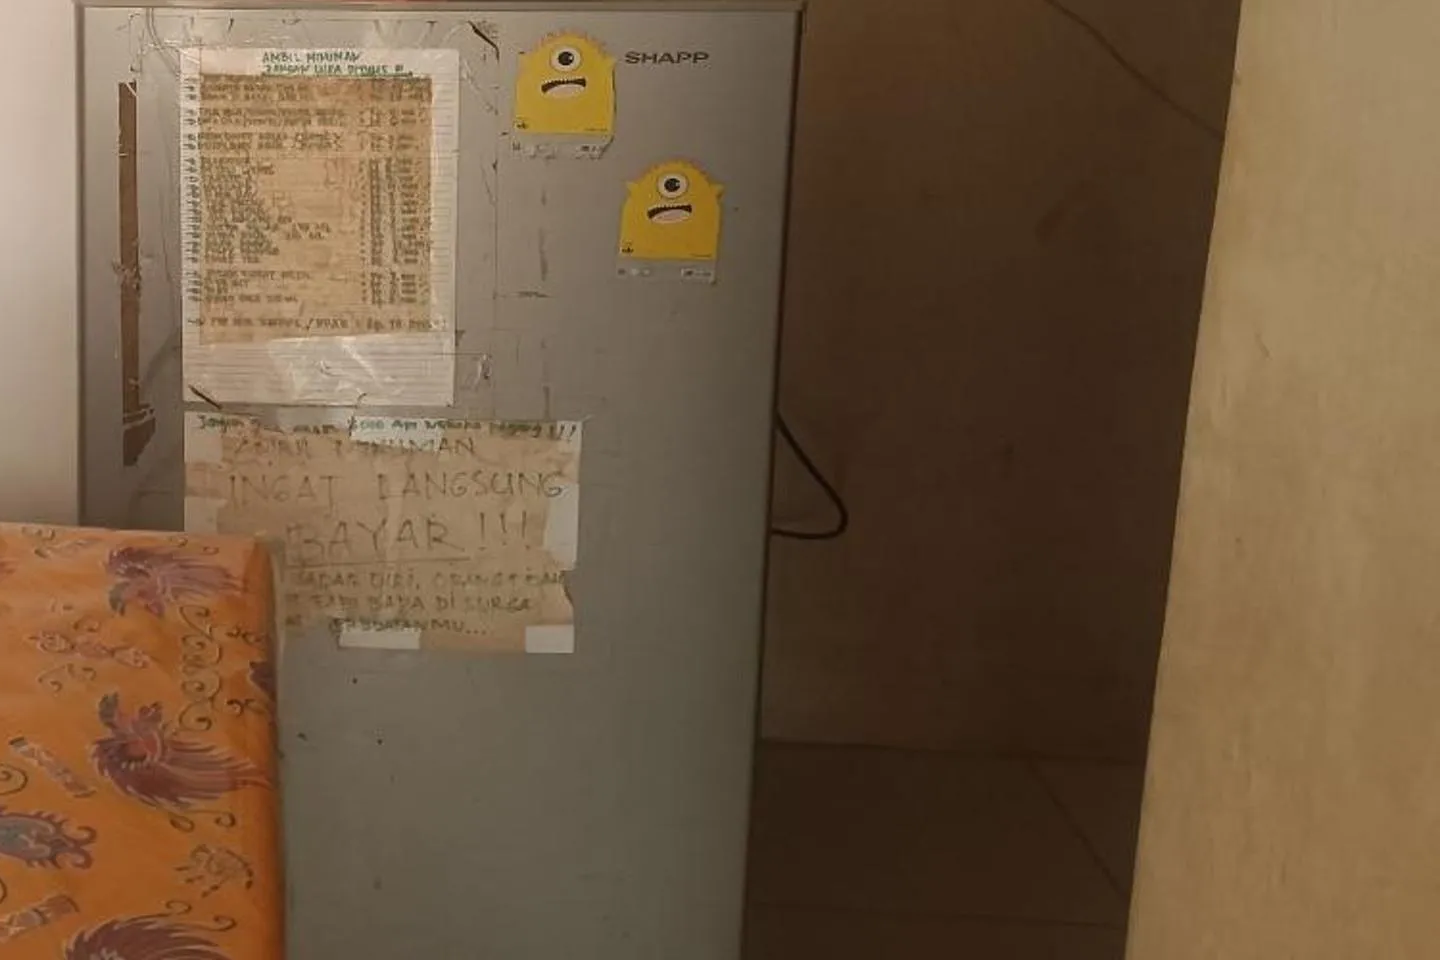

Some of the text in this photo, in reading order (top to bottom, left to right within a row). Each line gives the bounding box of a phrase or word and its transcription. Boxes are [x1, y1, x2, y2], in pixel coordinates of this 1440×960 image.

[229, 470, 566, 518] INGAT LANGSUNG
[286, 516, 466, 554] BAYAR
